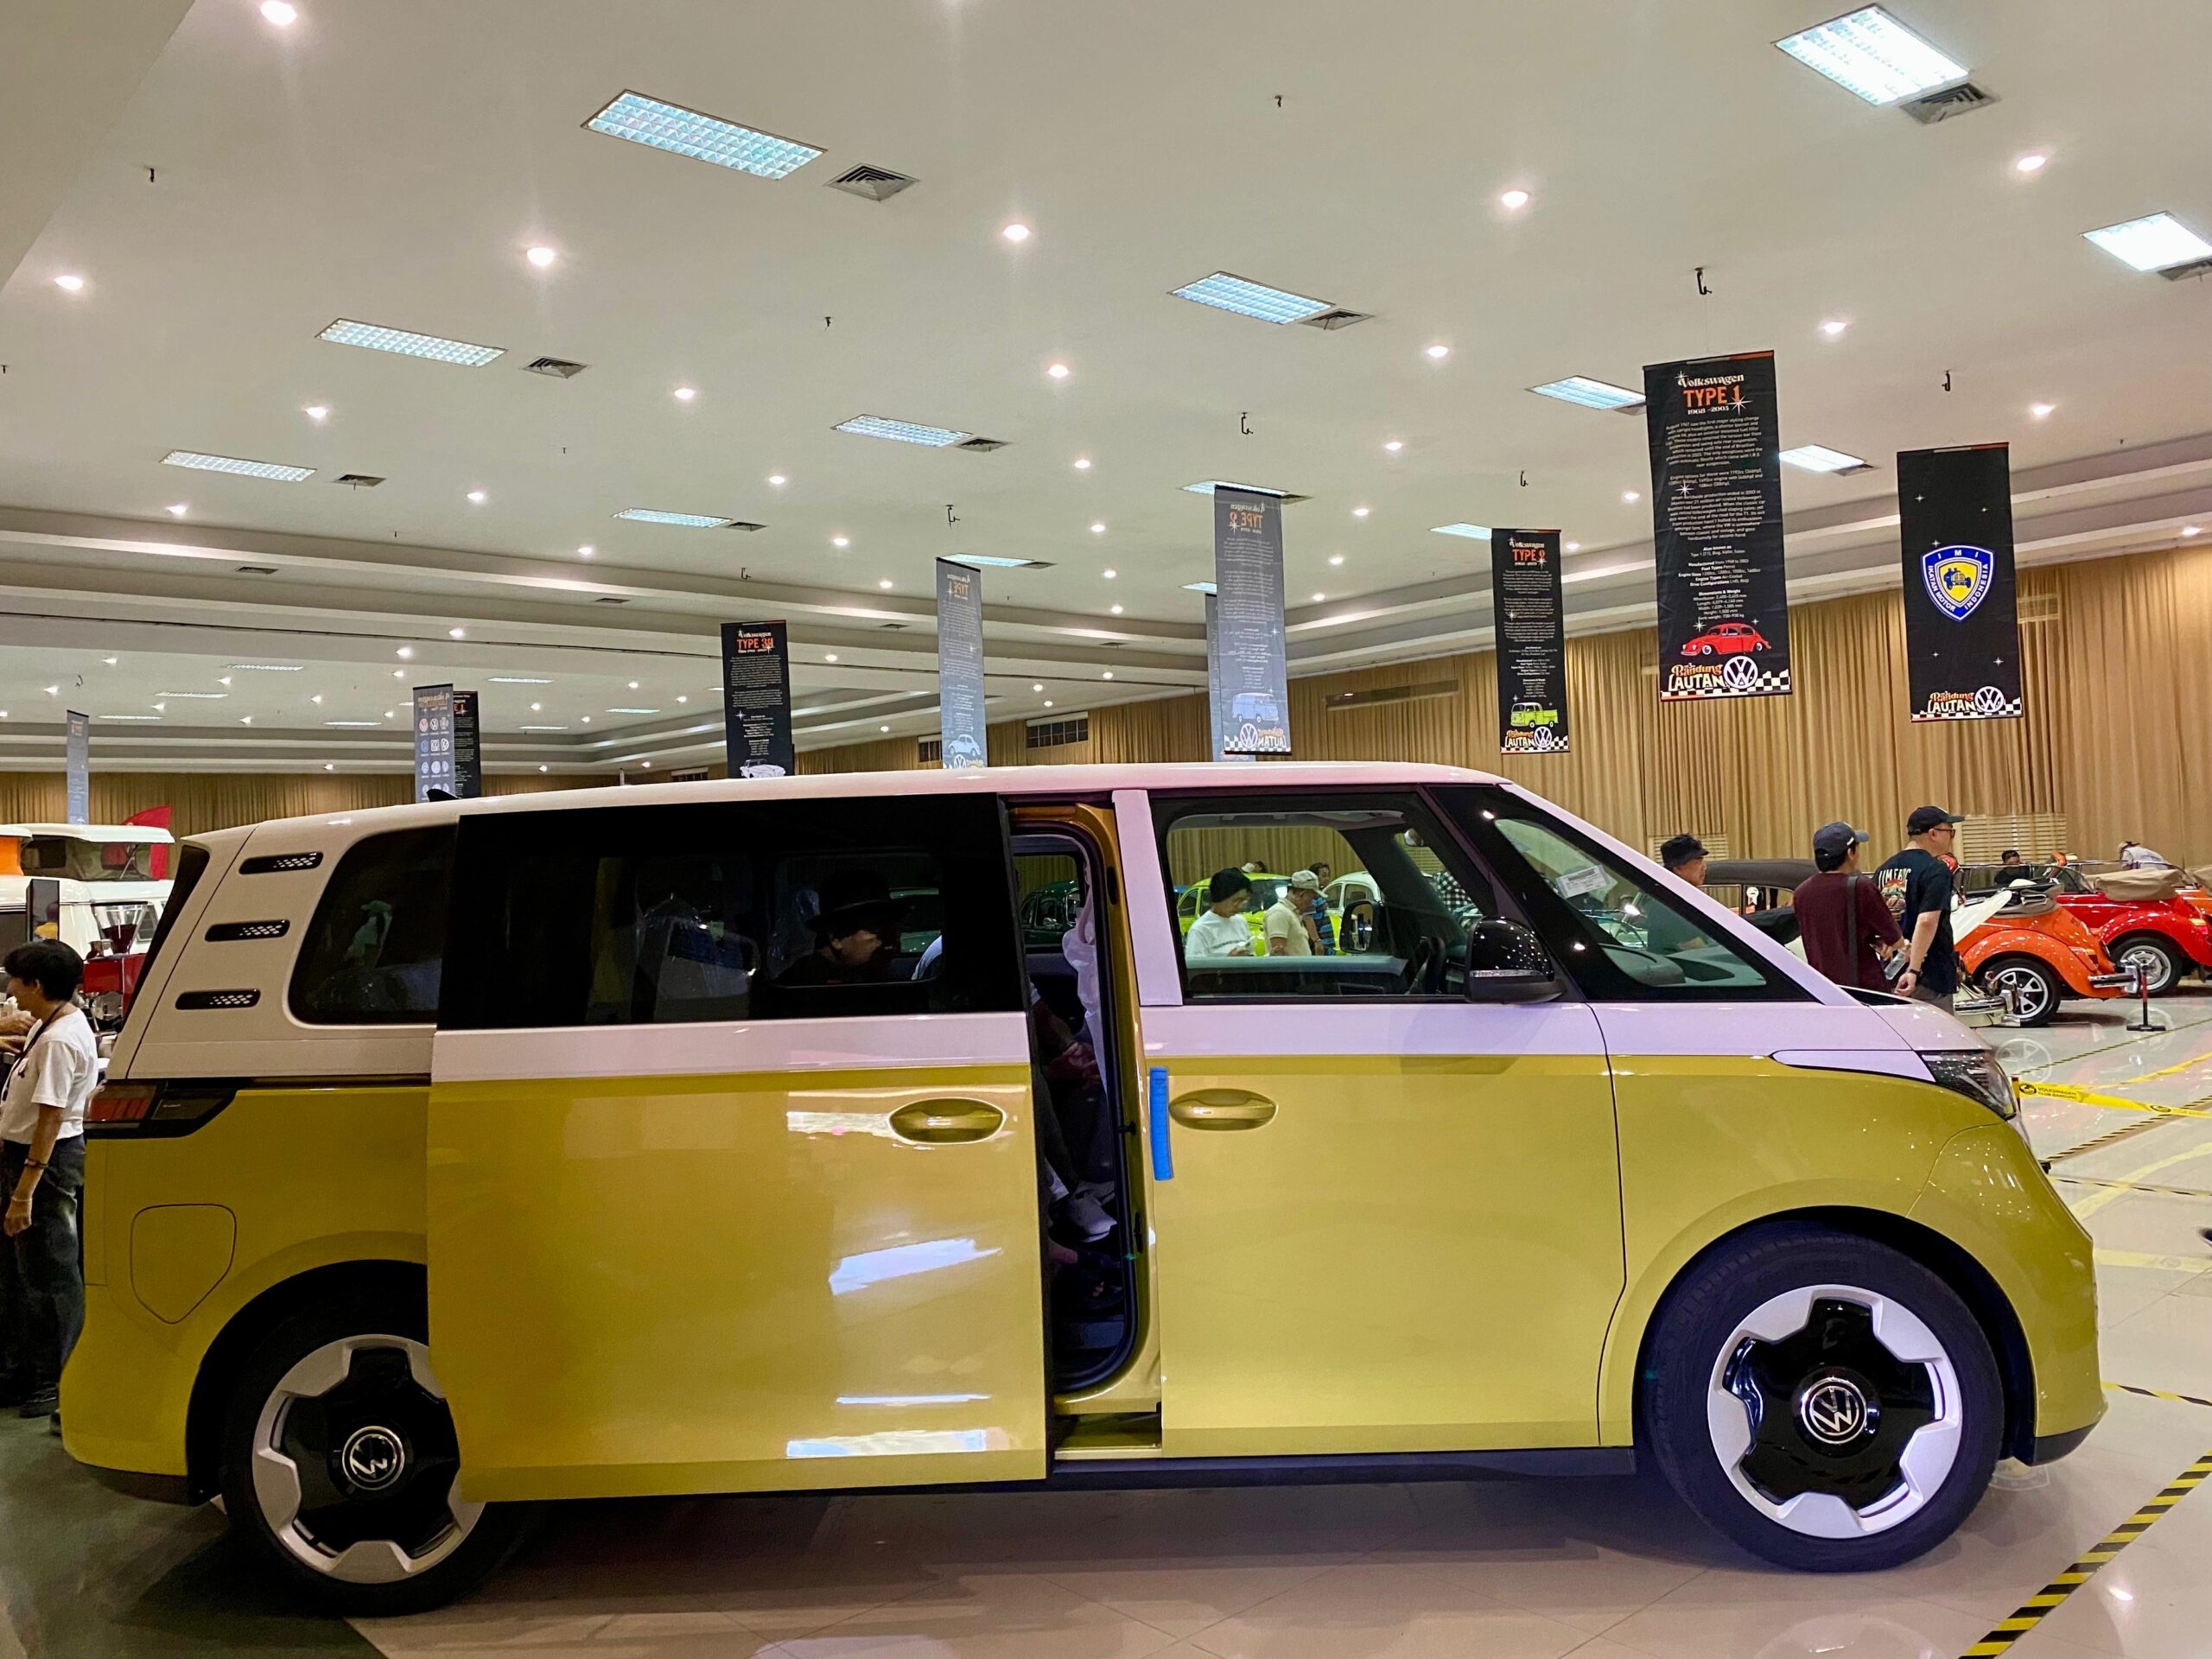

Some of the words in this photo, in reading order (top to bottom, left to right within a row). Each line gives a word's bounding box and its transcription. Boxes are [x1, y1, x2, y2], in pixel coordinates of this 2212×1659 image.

[1677, 374, 1744, 387] Volkswagen
[1683, 386, 1727, 407] TYPE
[1733, 385, 1740, 402] 1
[1512, 550, 1536, 561] TYPE
[1928, 565, 1936, 594] IKATAN
[1936, 591, 1956, 612] MOTOR
[1964, 563, 1988, 610] INDONESIA
[737, 639, 759, 650] TYPE
[1671, 664, 1722, 677] Bandung
[1669, 673, 1726, 691] LAUTAN
[1928, 699, 1977, 714] LAUTAN
[1505, 735, 1535, 747] LAUTAN
